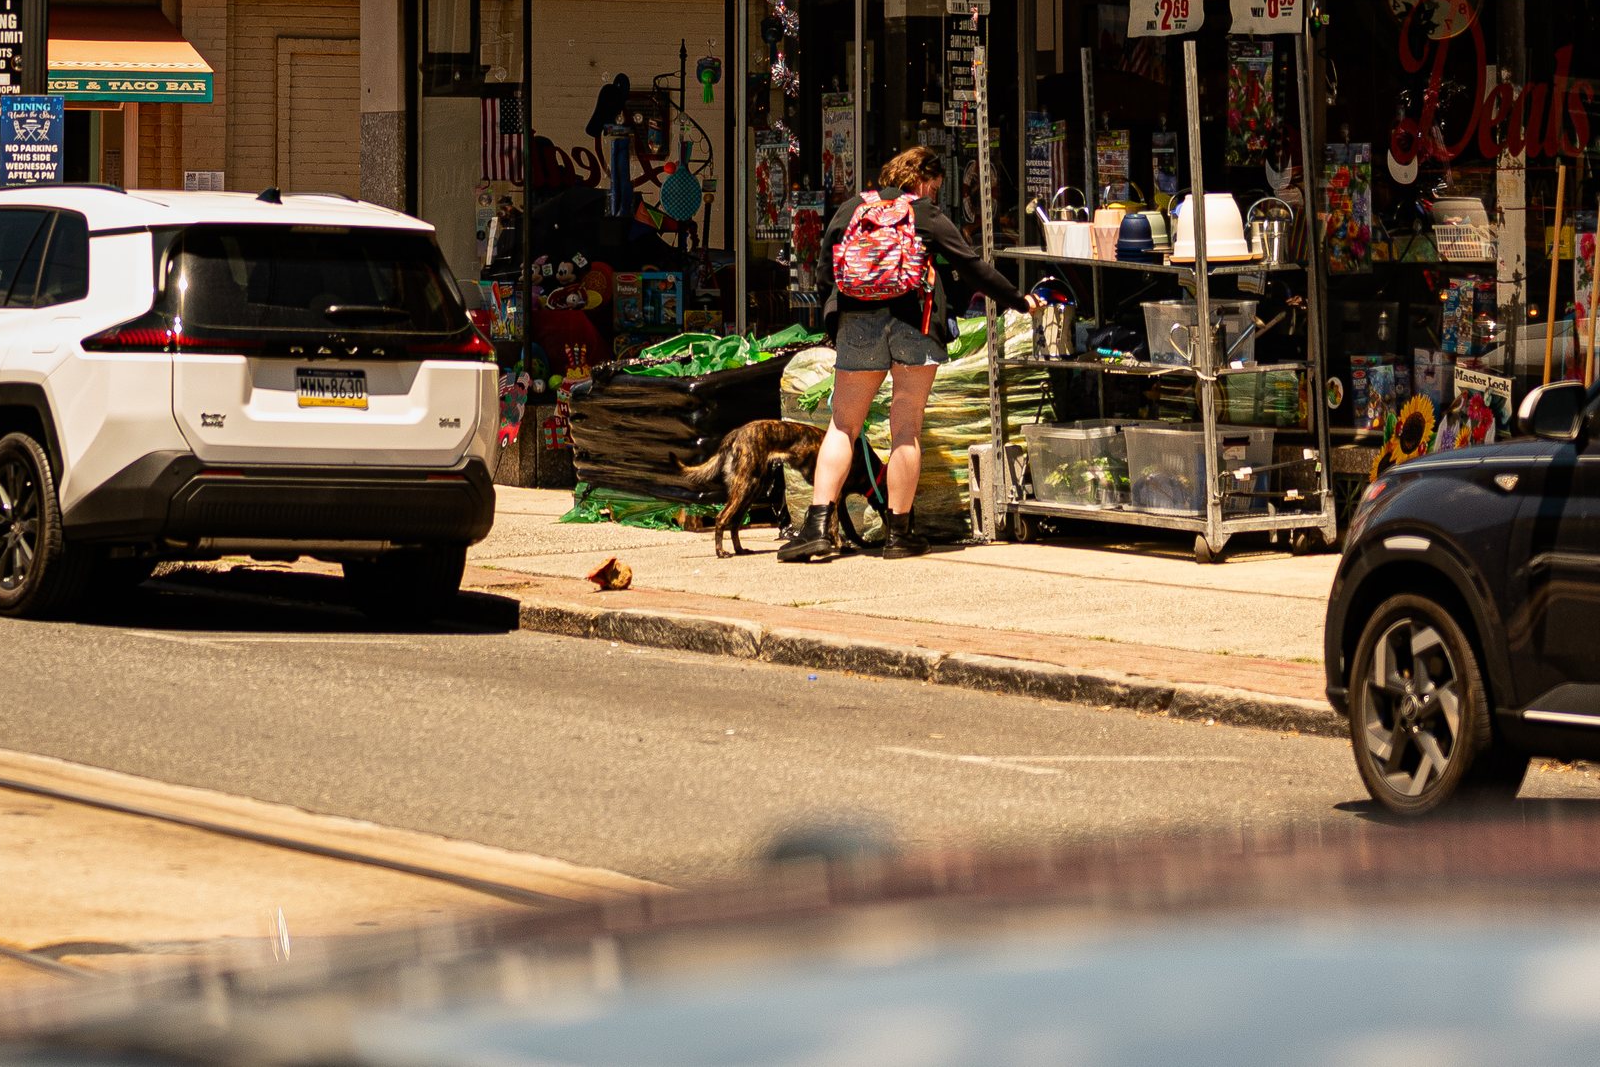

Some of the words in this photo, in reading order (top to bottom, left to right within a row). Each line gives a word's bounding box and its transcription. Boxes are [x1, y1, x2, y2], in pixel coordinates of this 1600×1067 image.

[86, 81, 100, 90] &
[108, 82, 158, 90] TACO
[166, 82, 206, 91] BAR
[13, 103, 51, 111] DINING
[5, 144, 18, 152] NO
[20, 144, 58, 152] PARKING
[12, 154, 31, 162] THIS
[32, 154, 51, 162] SIDE
[617, 285, 638, 294] Fishing
[1455, 370, 1487, 388] Master
[1488, 378, 1510, 392] Lock
